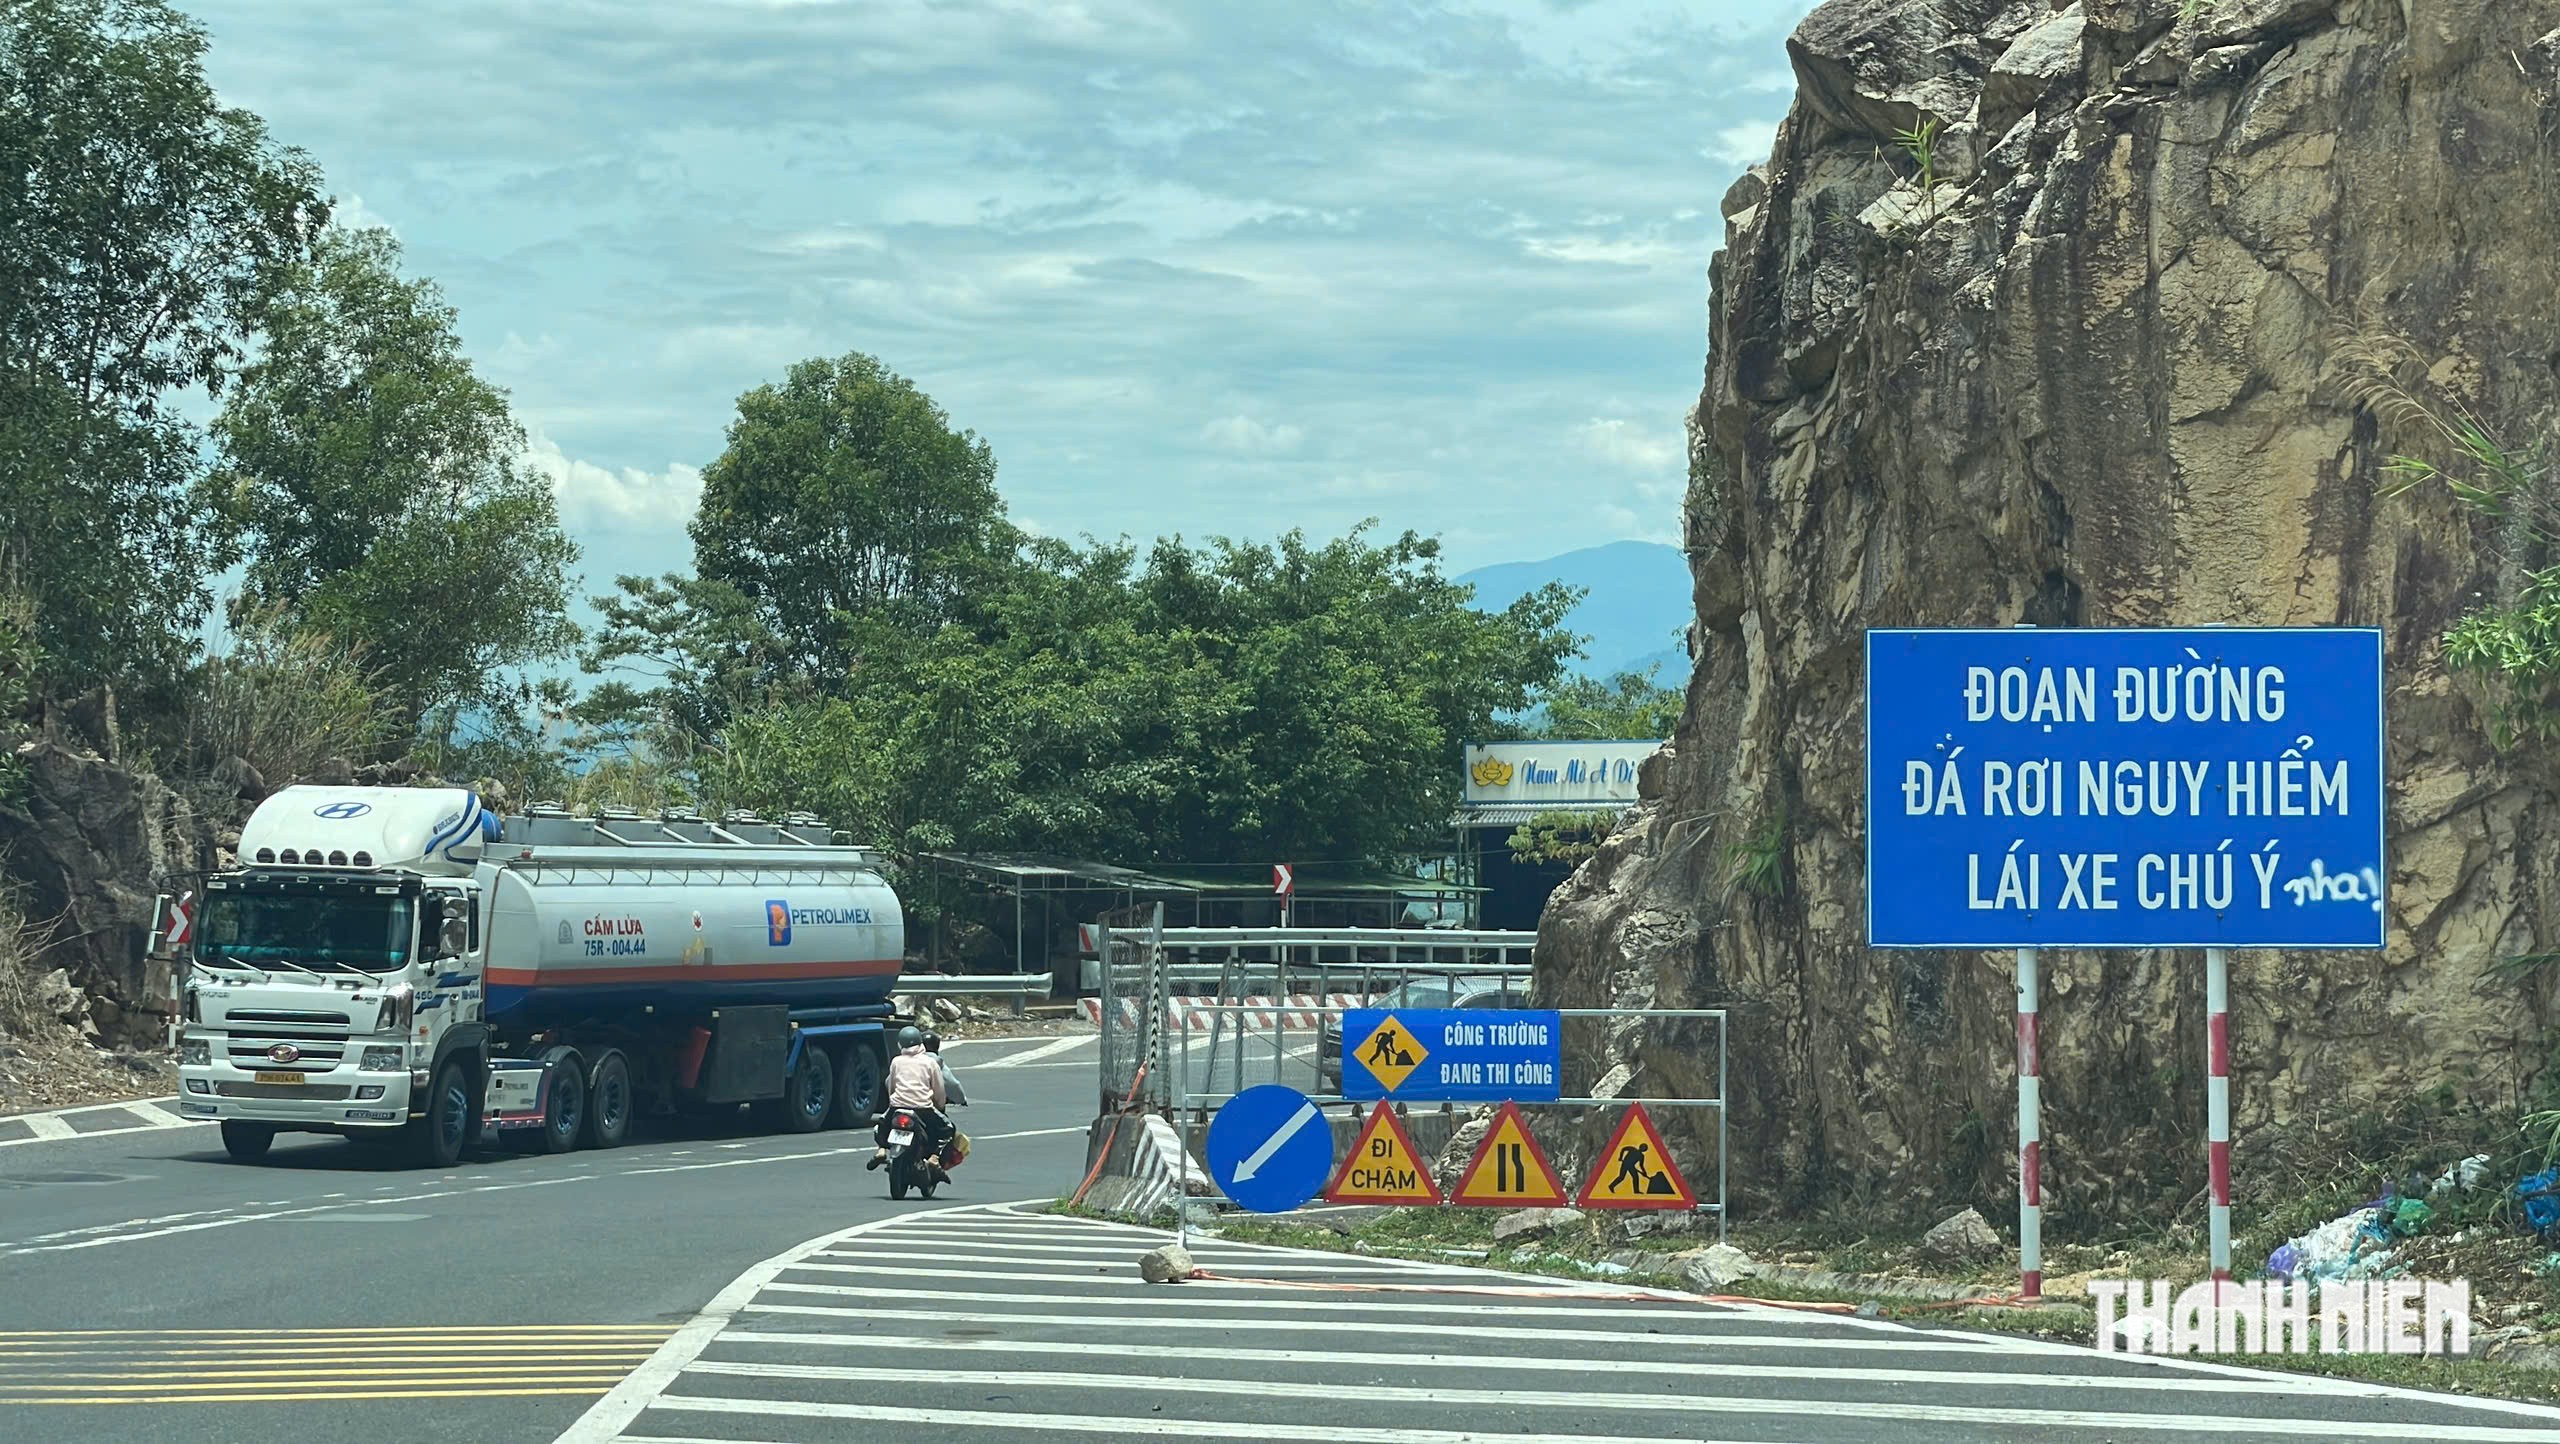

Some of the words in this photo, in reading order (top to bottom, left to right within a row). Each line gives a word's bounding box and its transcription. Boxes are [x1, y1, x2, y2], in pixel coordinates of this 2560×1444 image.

[1963, 666, 2095, 733] ĐOẠN
[2112, 647, 2286, 722] ĐƯỜNG
[1521, 759, 1558, 785] Nam
[1901, 746, 1967, 816] ĐÁ
[1984, 758, 2062, 816] RƠI
[2080, 760, 2209, 816] NGUY
[2228, 735, 2348, 816] HIỂM
[1968, 839, 2039, 910] LÁI
[2058, 854, 2118, 910] XE
[2137, 838, 2233, 910] CHÚ
[2250, 839, 2280, 909] Ý
[584, 913, 613, 936] CẤM
[792, 908, 872, 925] PETROLIMEX
[584, 940, 604, 956] 75R
[612, 938, 645, 956] 004.44
[1444, 1021, 1484, 1047] CÔNG
[1489, 1020, 1548, 1046] TRƯỜNG
[1440, 1064, 1481, 1085] ĐANG
[1486, 1063, 1510, 1085] THI
[1513, 1059, 1552, 1085] CÔNG
[1371, 1138, 1393, 1158] ĐI
[1351, 1167, 1416, 1192] CHẬM
